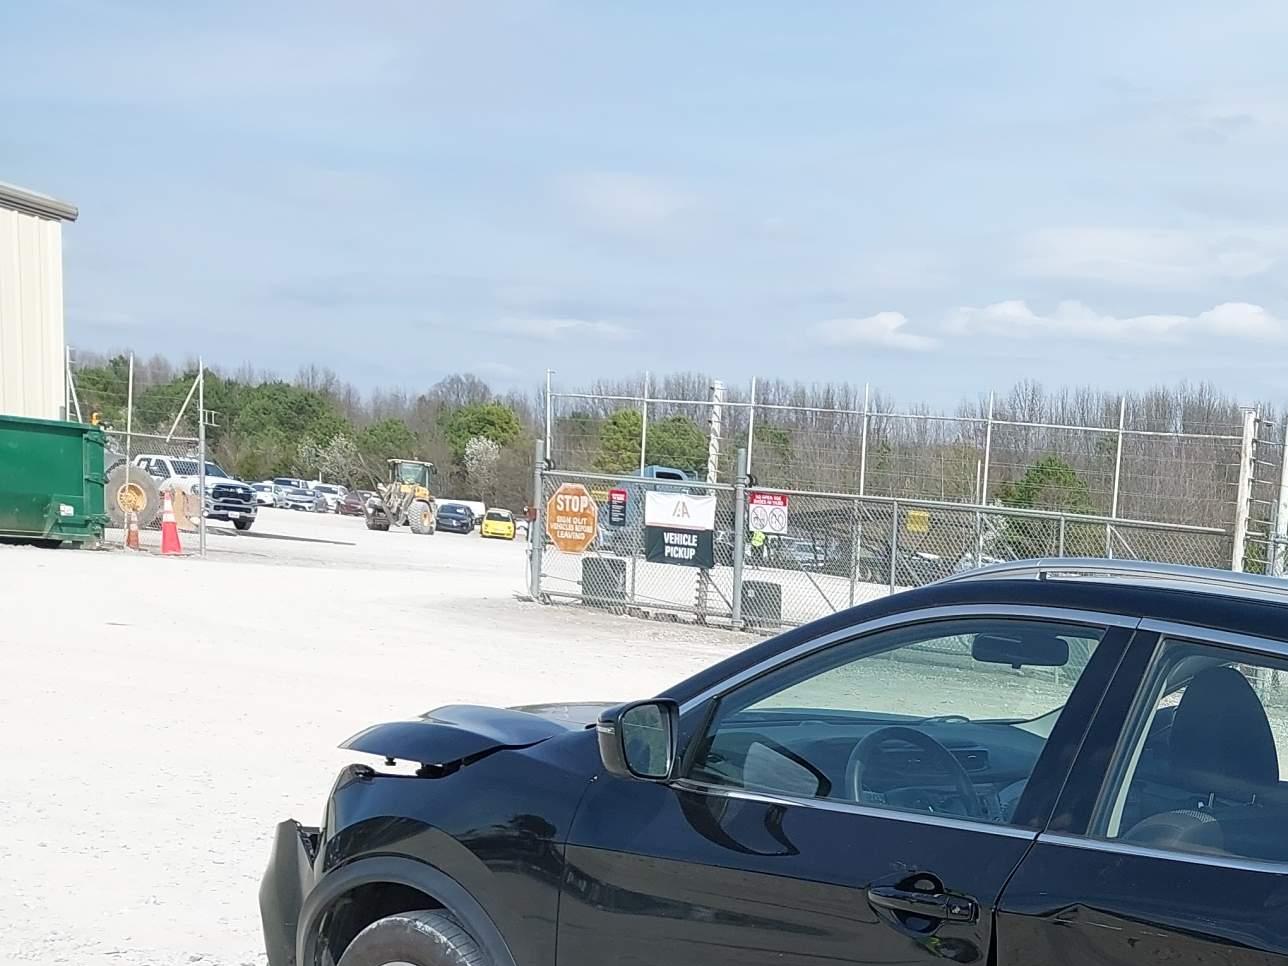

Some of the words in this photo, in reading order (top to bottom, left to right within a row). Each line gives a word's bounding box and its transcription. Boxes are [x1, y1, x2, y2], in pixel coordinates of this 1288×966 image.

[556, 494, 588, 512] STOP
[573, 517, 587, 525] OUT
[556, 531, 585, 540] LEAVING
[663, 532, 698, 547] VEHICLE
[664, 545, 696, 559] PICKUP
